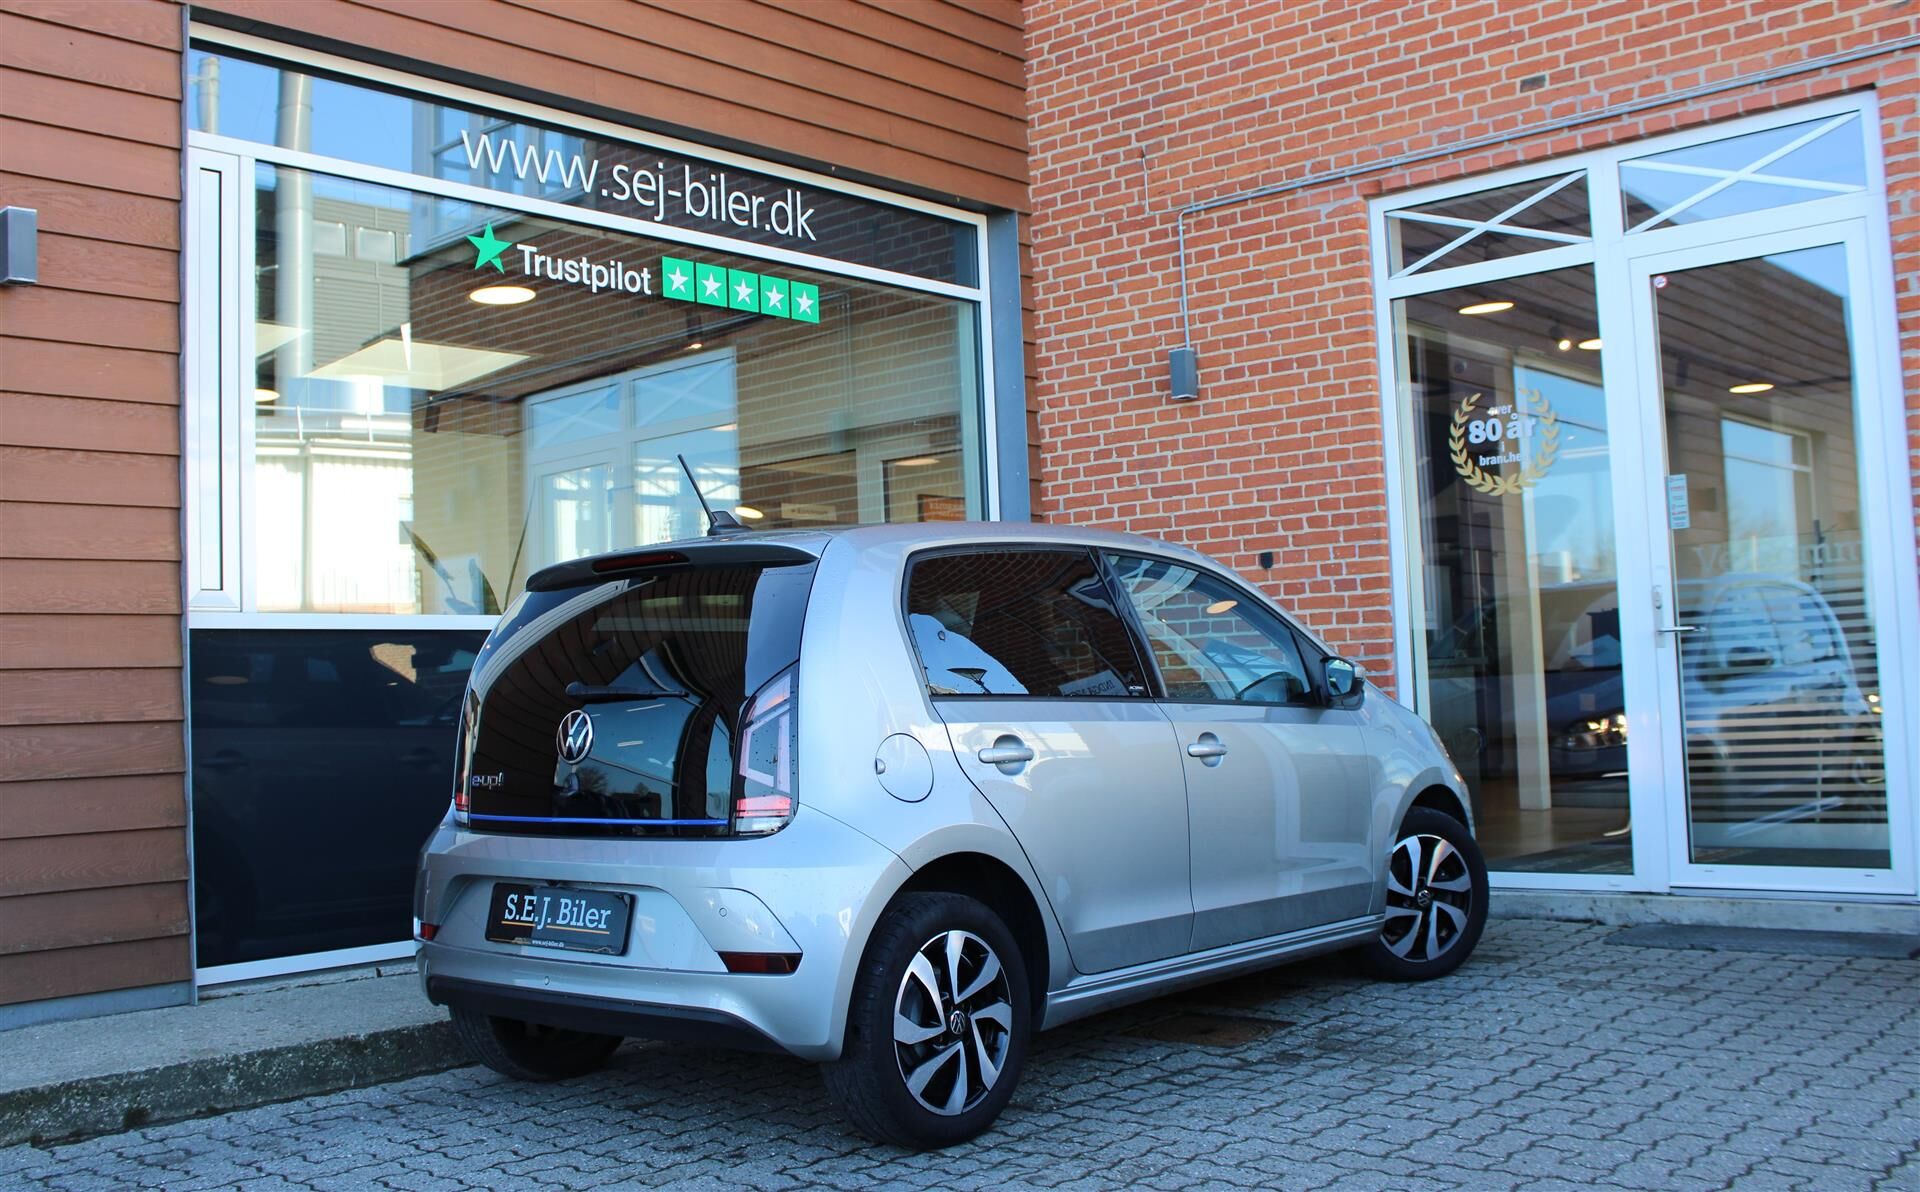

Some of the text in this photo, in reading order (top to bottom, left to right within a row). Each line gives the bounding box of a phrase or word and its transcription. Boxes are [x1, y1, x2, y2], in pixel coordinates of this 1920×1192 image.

[461, 129, 817, 241] www.sej-biler.dk
[516, 243, 652, 294] Trustpilot
[1468, 412, 1537, 444] 80 år
[504, 893, 611, 930] S.E.J. Biler
